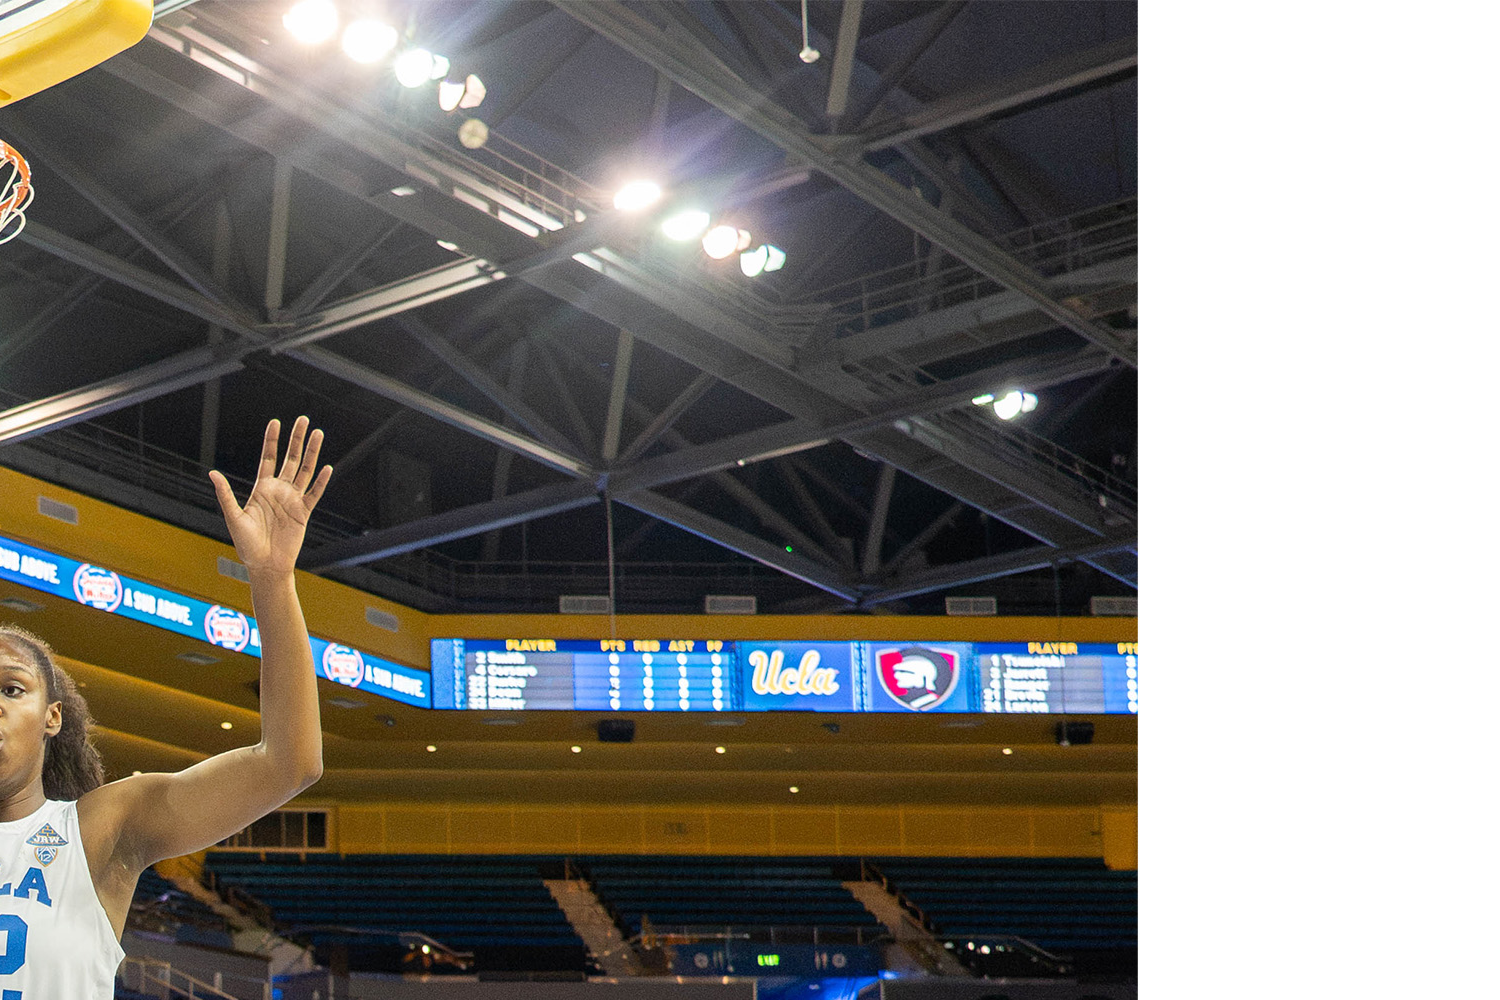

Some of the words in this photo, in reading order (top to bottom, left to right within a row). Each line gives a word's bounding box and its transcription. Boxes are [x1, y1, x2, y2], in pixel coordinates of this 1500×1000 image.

[506, 639, 556, 651] PLAYER
[668, 640, 694, 653] AST
[1027, 642, 1078, 654] PLAYER
[749, 649, 839, 695] Ucla
